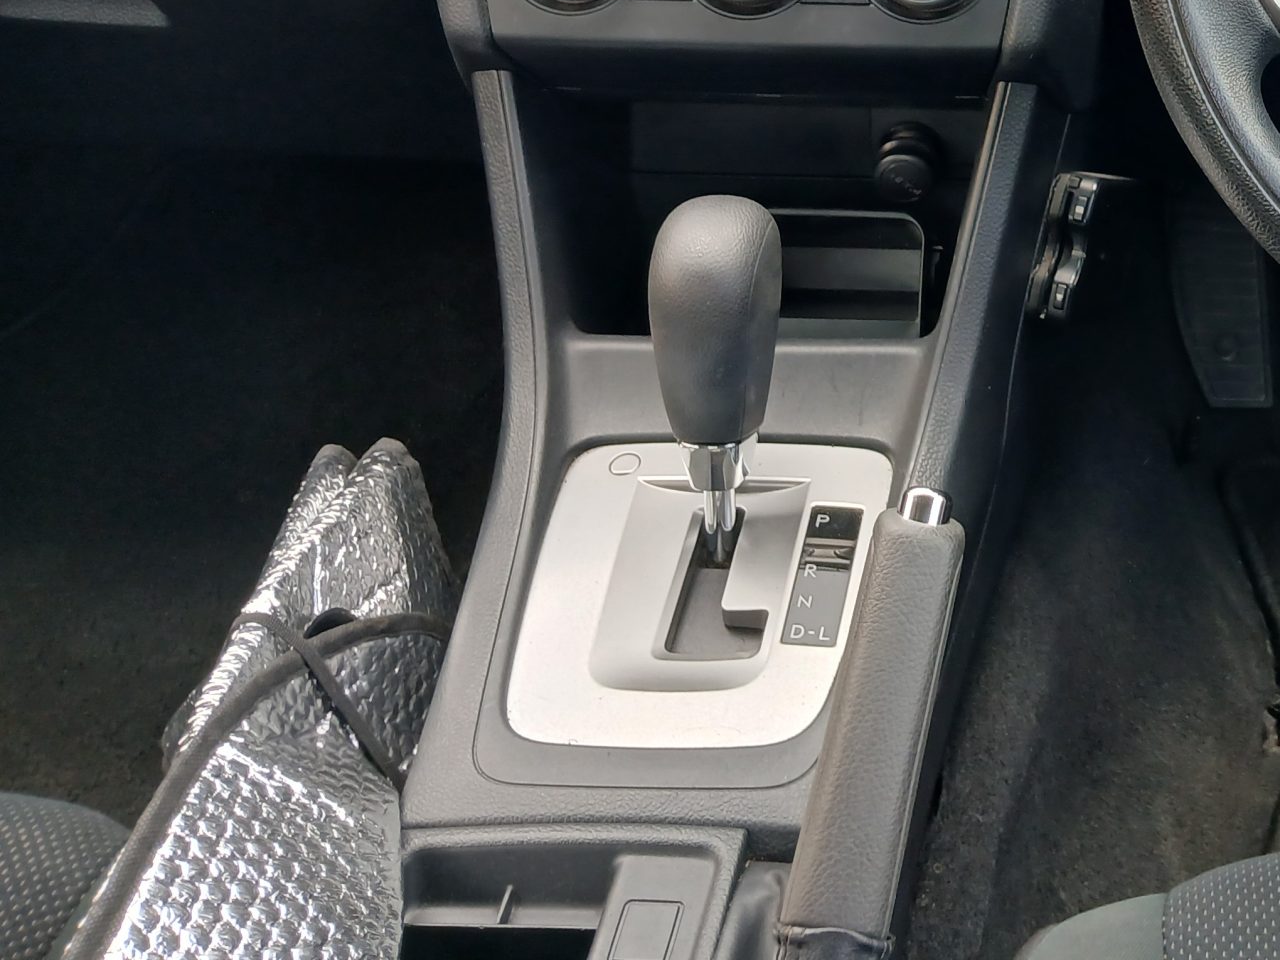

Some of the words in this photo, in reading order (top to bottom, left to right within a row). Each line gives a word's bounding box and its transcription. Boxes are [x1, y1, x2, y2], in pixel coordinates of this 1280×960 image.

[815, 513, 831, 529] P
[803, 563, 818, 579] R
[797, 595, 813, 609] N
